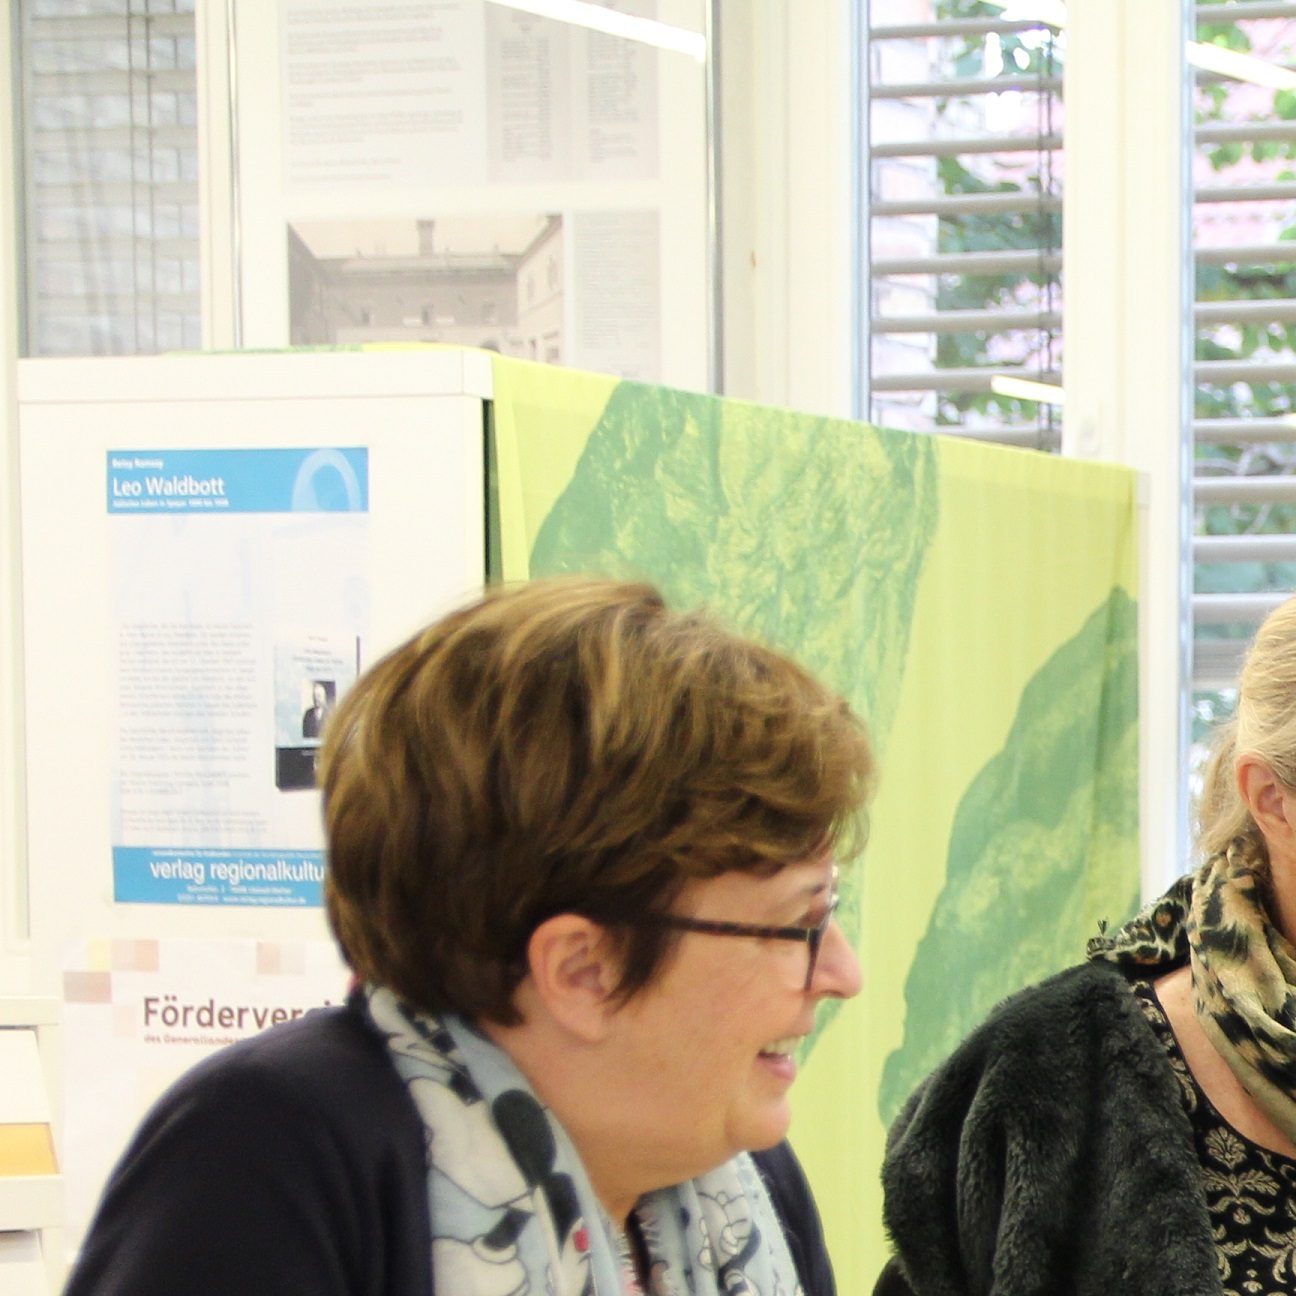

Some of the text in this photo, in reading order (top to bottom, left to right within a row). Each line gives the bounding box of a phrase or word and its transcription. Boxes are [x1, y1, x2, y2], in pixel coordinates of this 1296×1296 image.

[113, 475, 225, 497] Leo Waldbott
[150, 858, 324, 884] verlag regionalkultu
